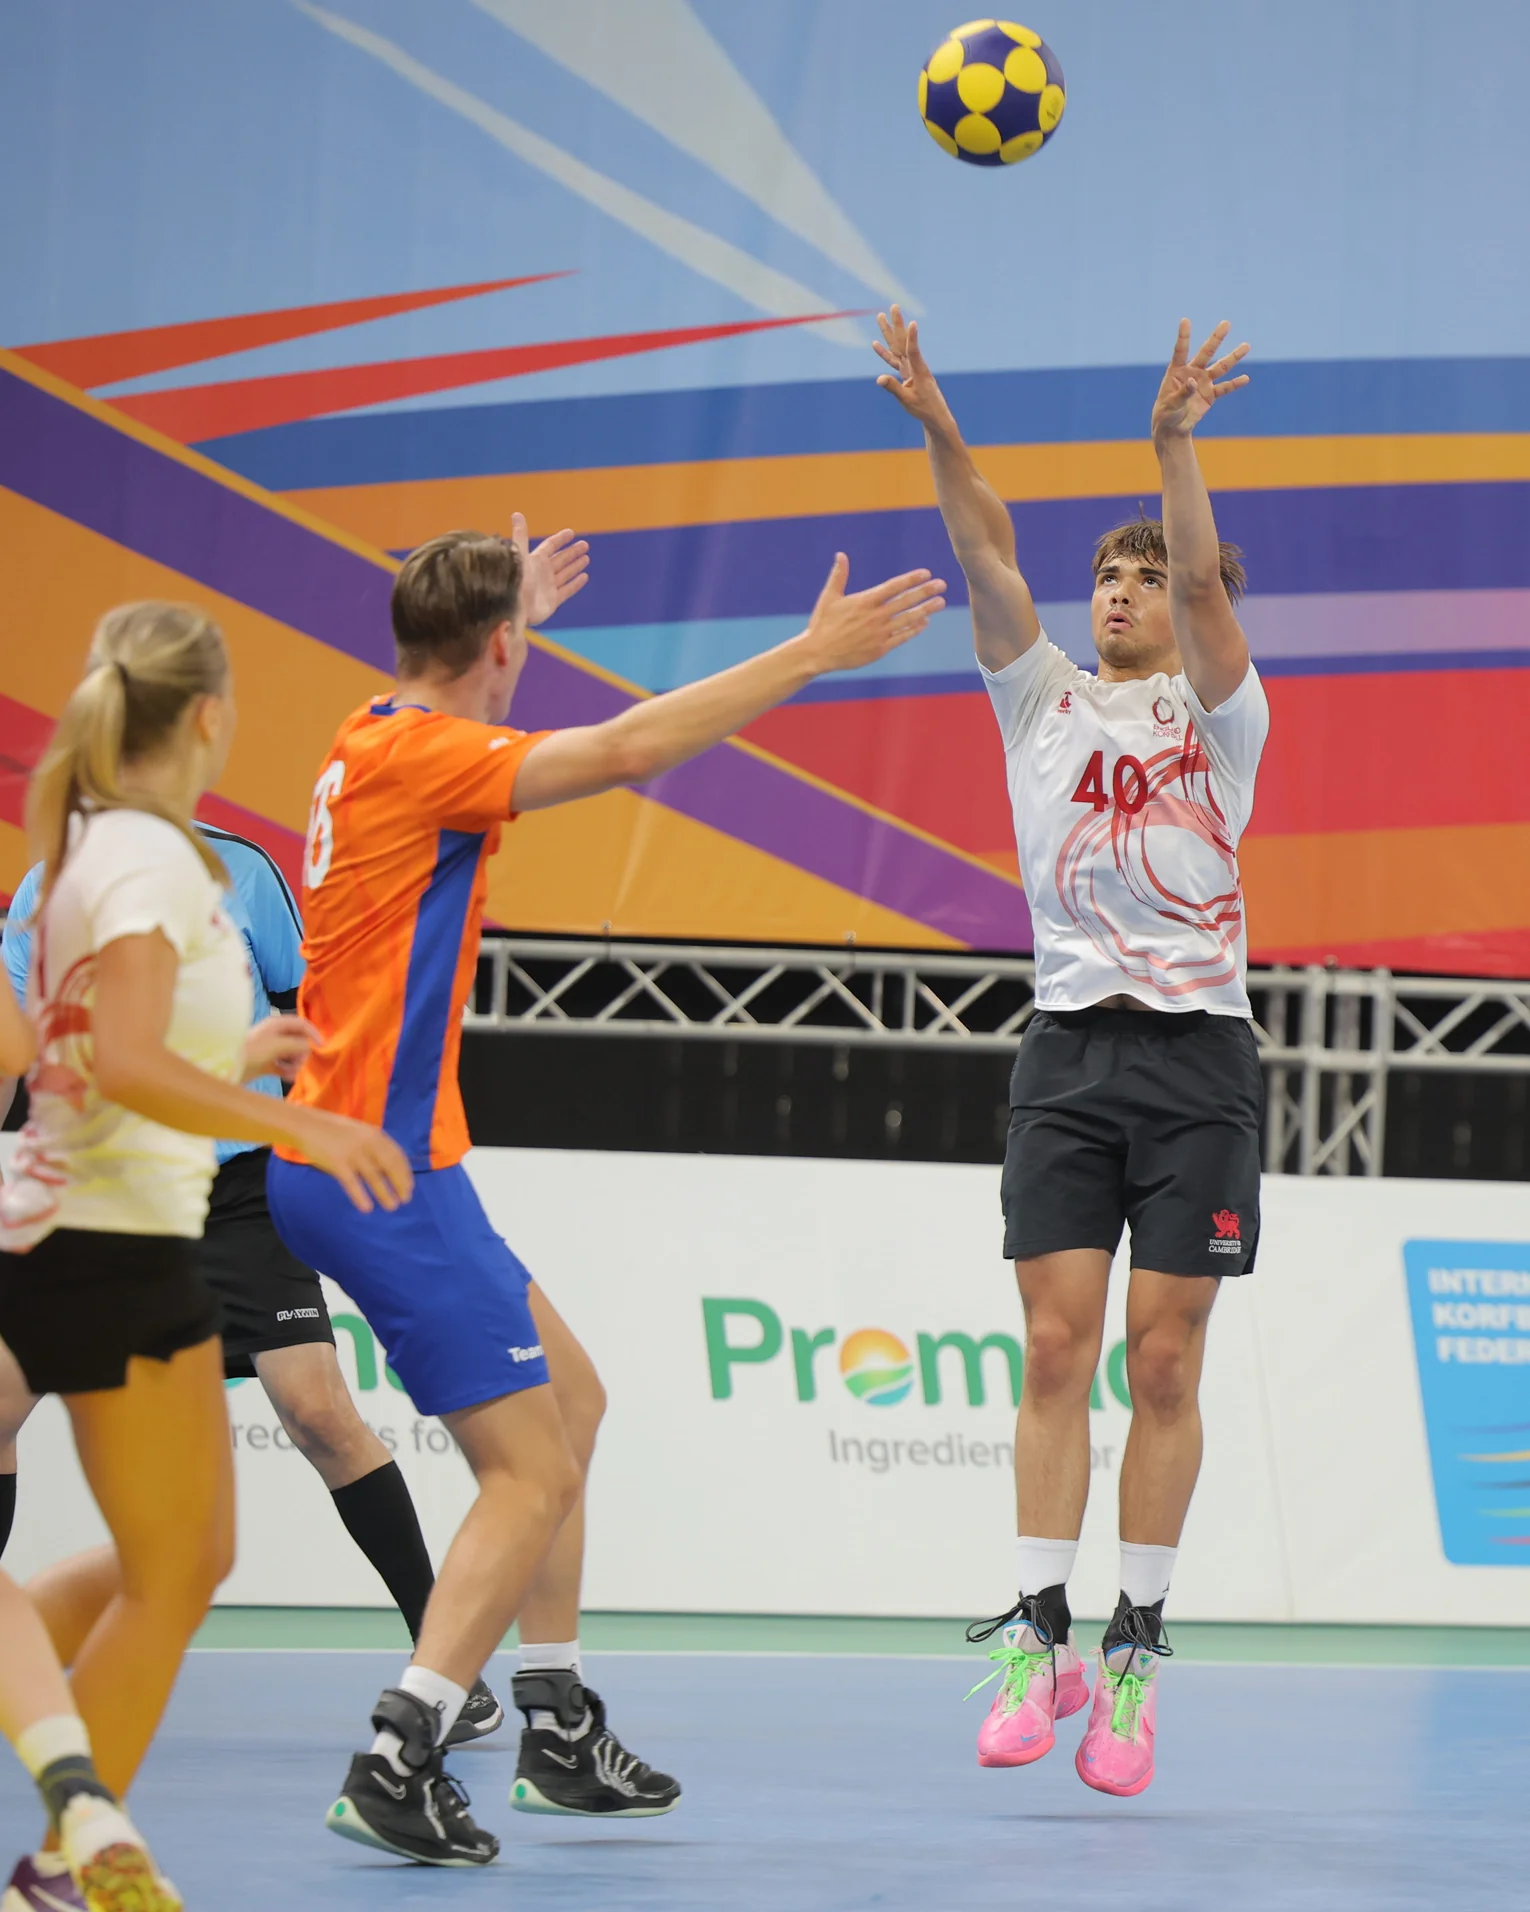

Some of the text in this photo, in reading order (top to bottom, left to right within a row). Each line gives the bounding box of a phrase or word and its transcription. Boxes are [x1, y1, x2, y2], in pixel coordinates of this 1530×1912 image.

[1071, 750, 1148, 815] 40
[700, 1296, 1134, 1411] Prom
[828, 1429, 1015, 1474] Ingredien
